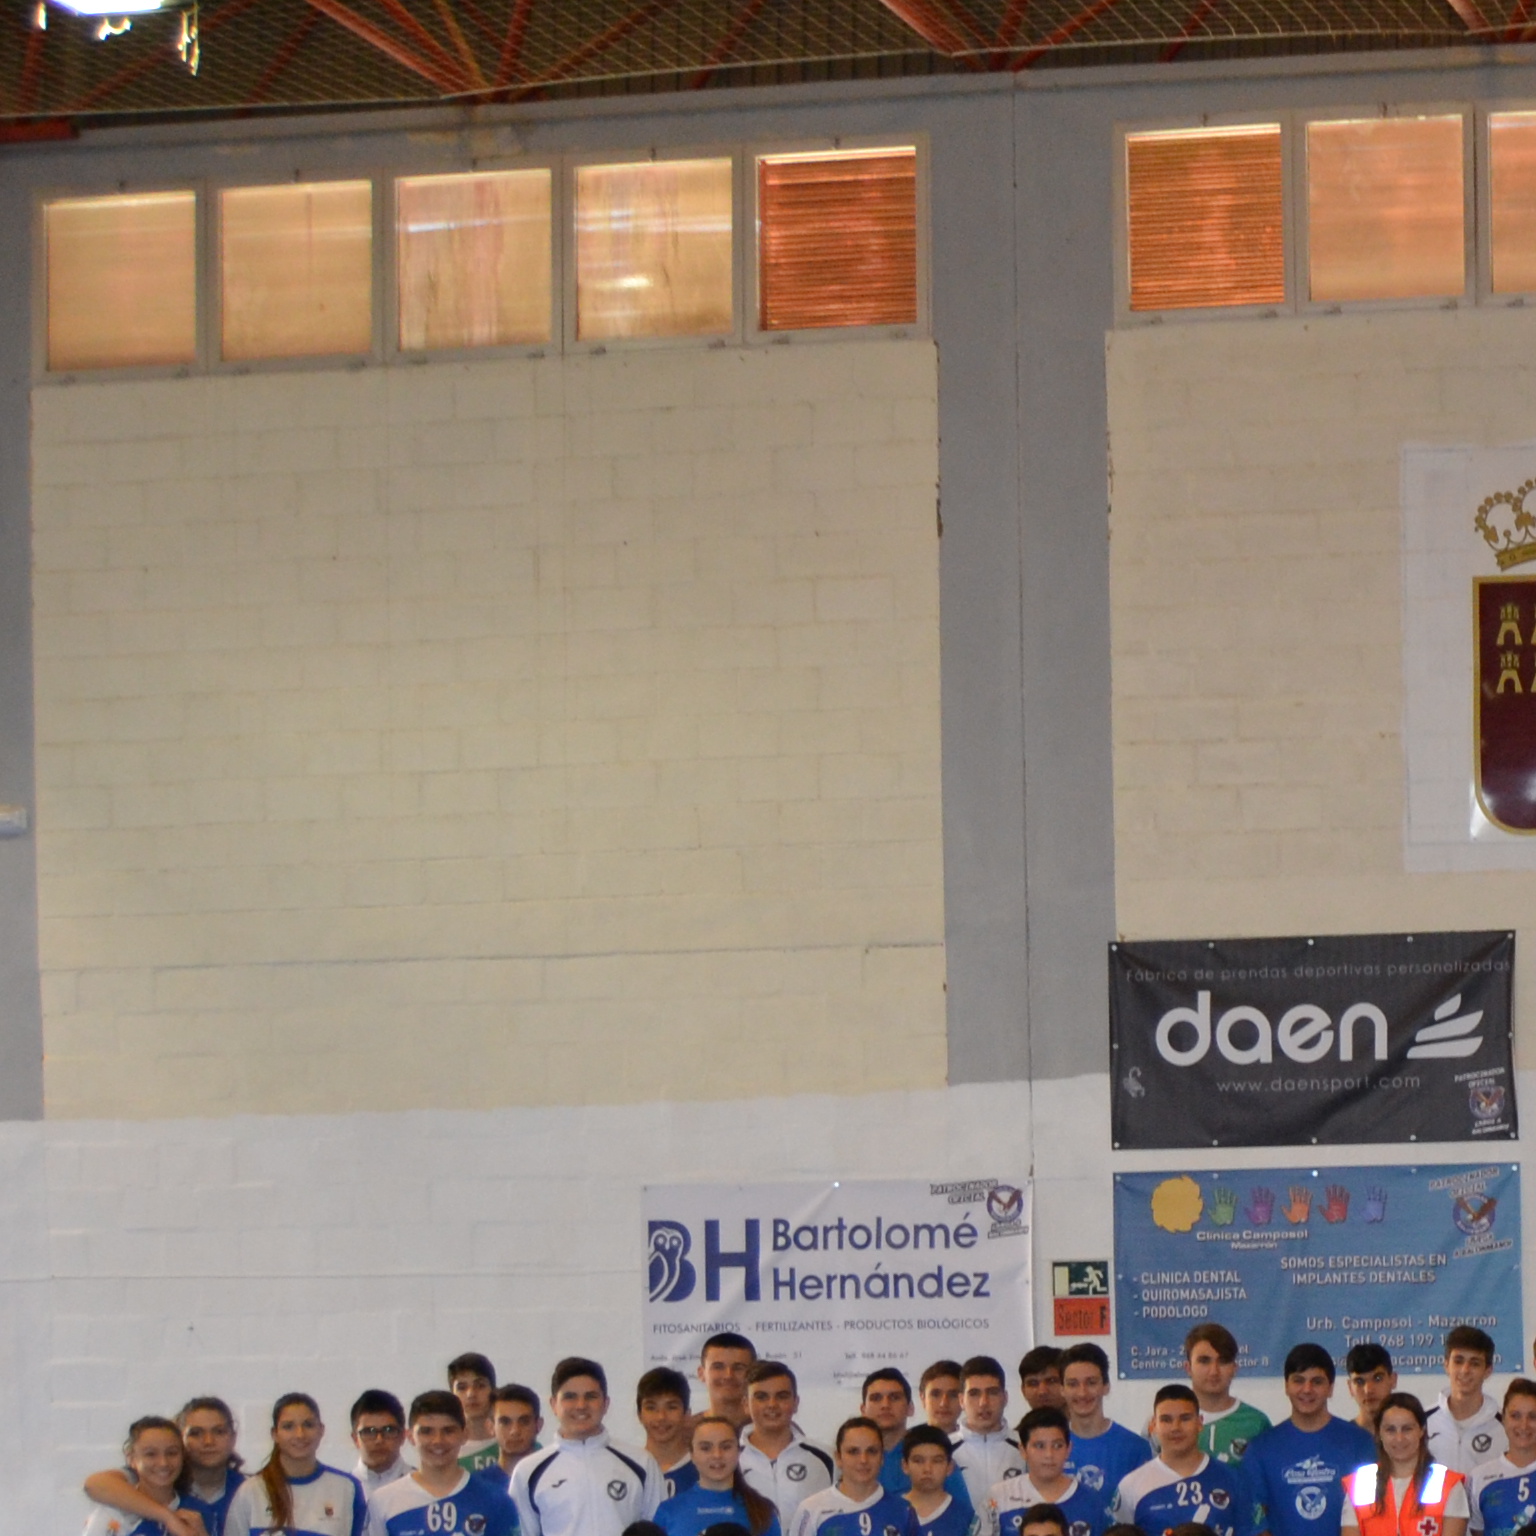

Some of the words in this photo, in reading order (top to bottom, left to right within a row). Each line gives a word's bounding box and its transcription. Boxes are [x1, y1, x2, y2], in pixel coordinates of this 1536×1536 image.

[1126, 969, 1187, 982] Fábrica
[1194, 968, 1214, 981] de
[1220, 966, 1287, 982] prendas
[1295, 962, 1380, 979] deportivas
[1388, 959, 1510, 977] personalizadas
[1156, 990, 1388, 1066] daen
[1216, 1074, 1420, 1094] www.daensport.com
[772, 1212, 978, 1252] Bartolomé
[1281, 1255, 1324, 1270] SOMOS
[1329, 1254, 1424, 1268] ESPECIALISTAS
[1424, 1253, 1447, 1267] EN
[773, 1263, 990, 1301] Hernández
[1193, 1270, 1241, 1284] DENTAL
[1292, 1272, 1365, 1286] IMPLANTES
[1369, 1270, 1436, 1284] DENTALES
[1142, 1287, 1247, 1302] QUIROMASAJISTA
[1099, 1300, 1108, 1325] F
[1142, 1305, 1208, 1319] PODOLOGO
[653, 1321, 741, 1334] FITOSANITARIOS
[755, 1319, 832, 1332] FERTILIZANTES
[843, 1318, 914, 1332] PRODUCTOS
[1306, 1316, 1338, 1331] Urb.
[1342, 1315, 1412, 1331] Camposol
[1175, 1482, 1203, 1508] 23
[1517, 1481, 1531, 1502] 5
[426, 1501, 458, 1533] 69
[858, 1512, 873, 1536] 9
